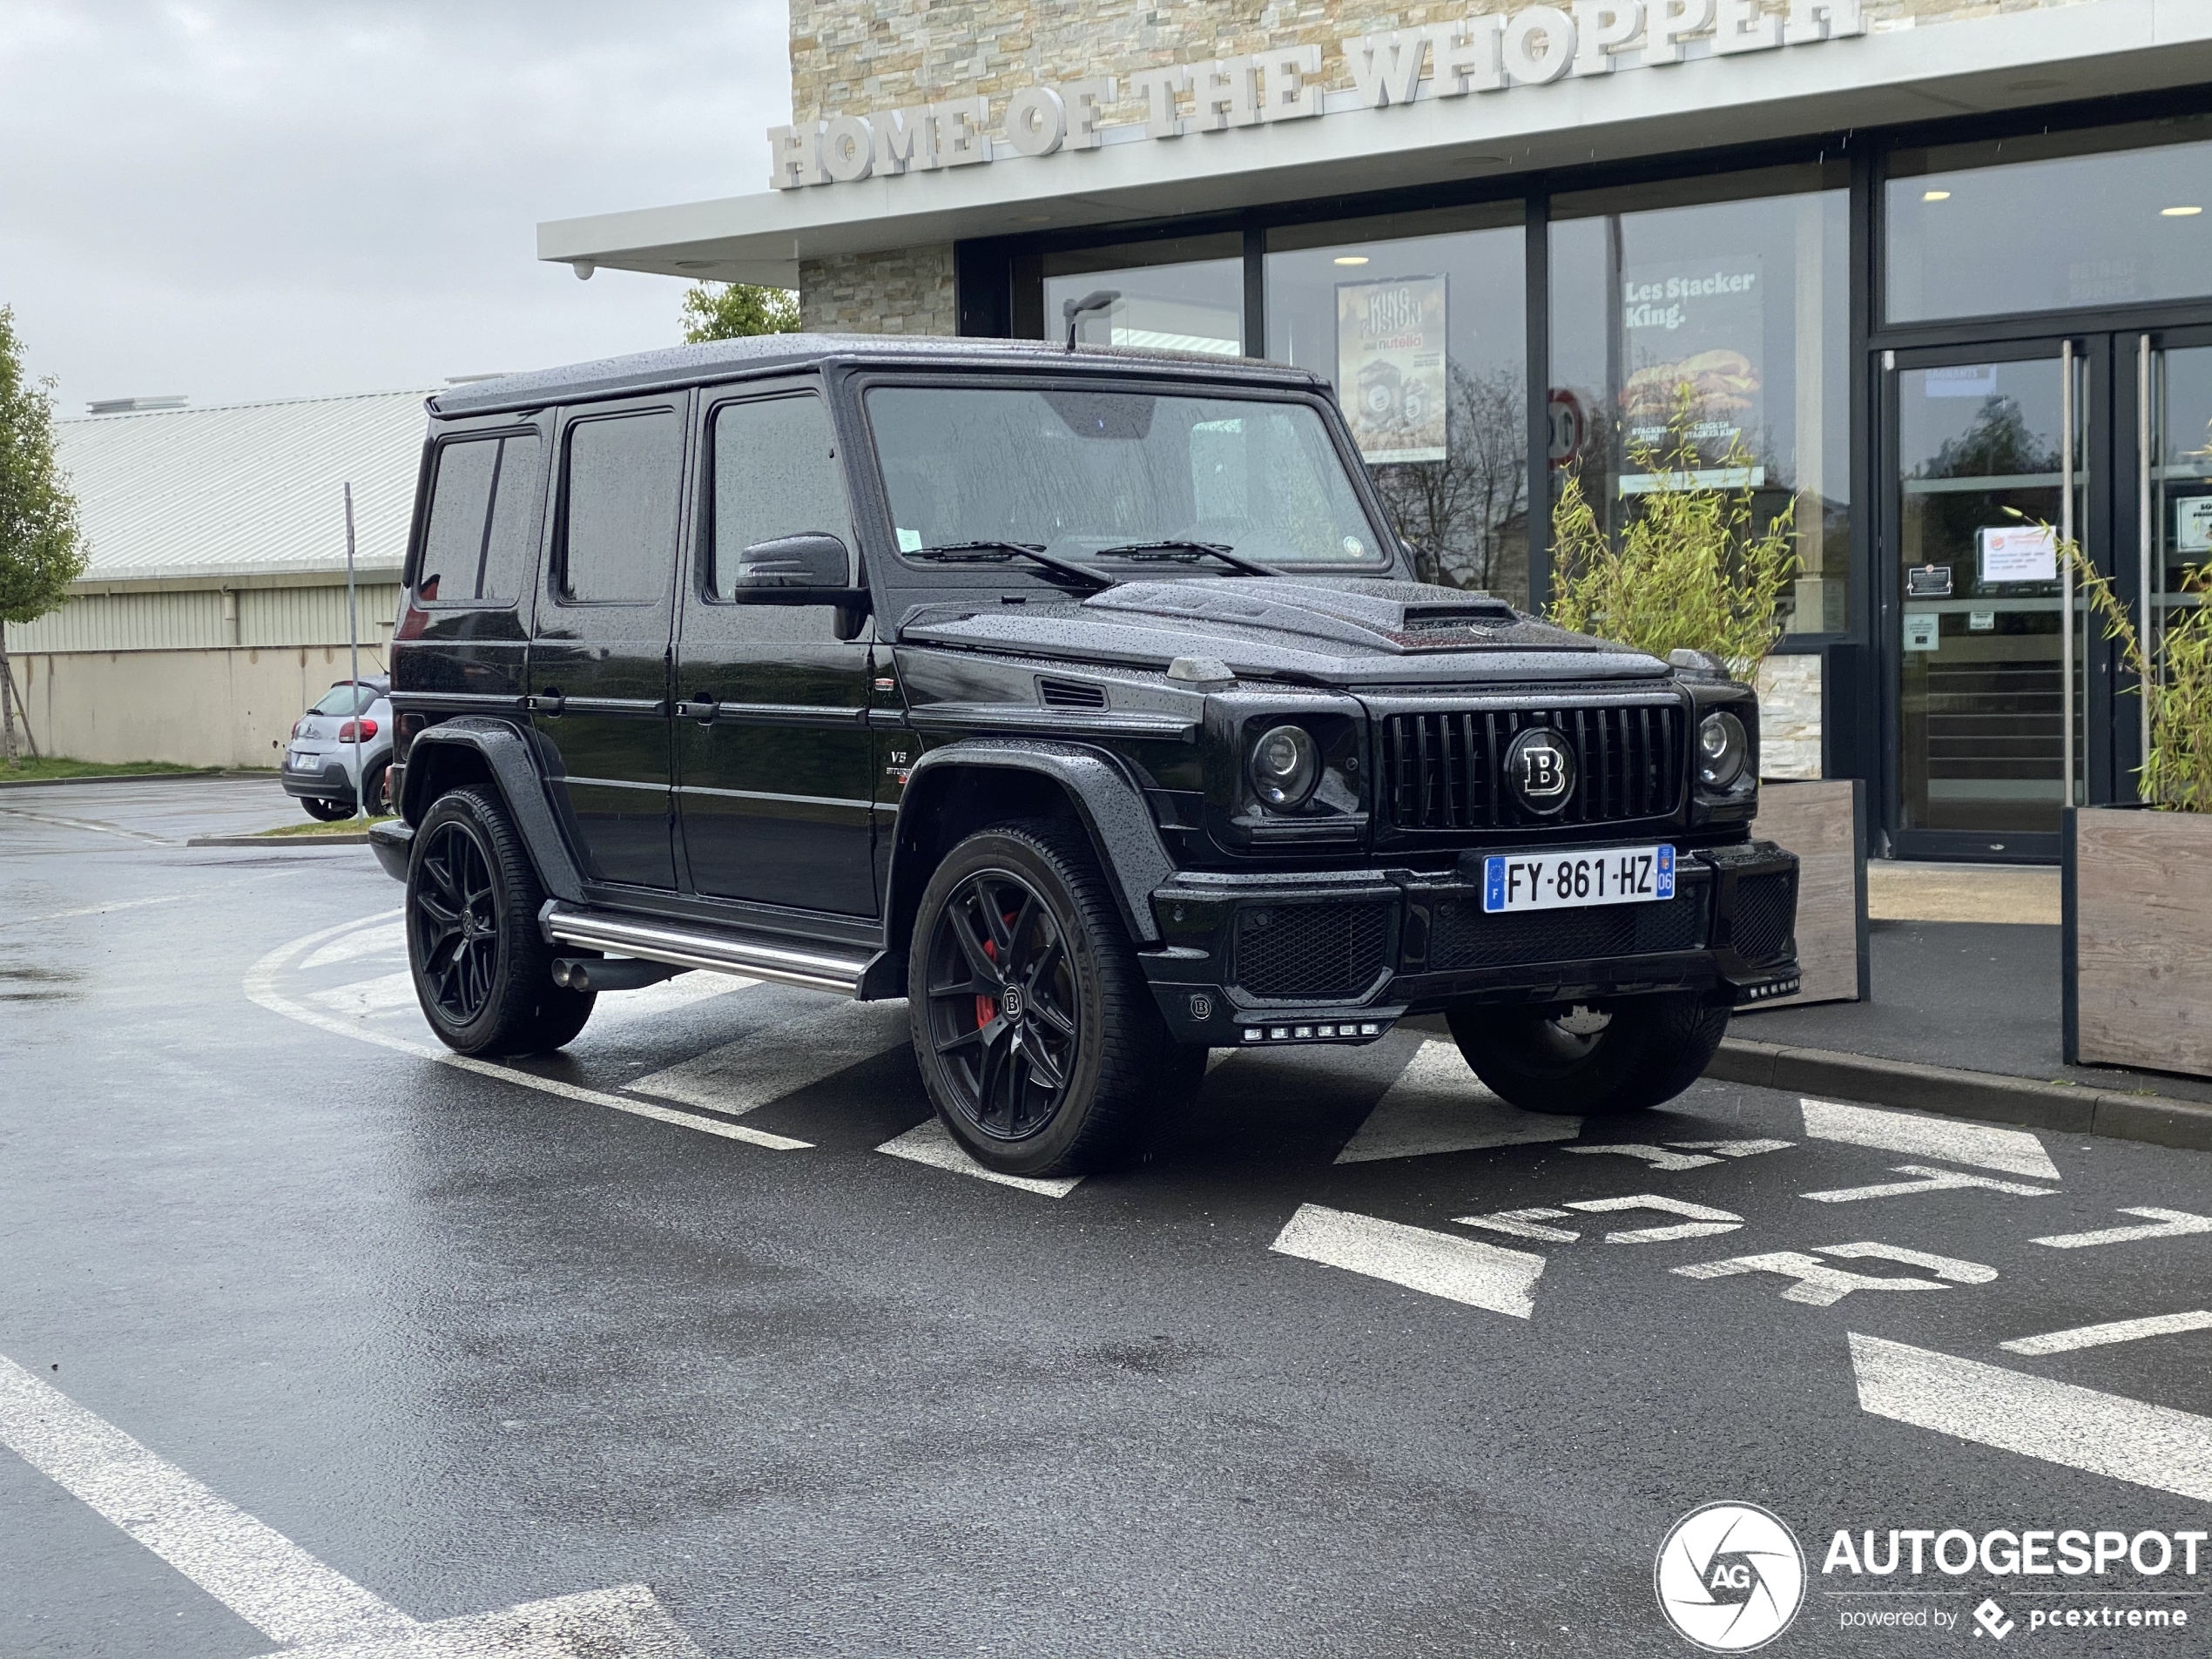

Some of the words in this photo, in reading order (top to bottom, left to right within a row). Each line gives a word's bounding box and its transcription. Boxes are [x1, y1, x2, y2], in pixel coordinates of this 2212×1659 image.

[767, 96, 992, 190] HOME
[1006, 77, 1117, 155] OF
[1132, 44, 1323, 138] THE
[1625, 282, 1663, 302] Les
[1666, 272, 1756, 298] Stacker
[1370, 287, 1410, 318] KING
[1360, 301, 1422, 338] FUSION
[1625, 304, 1686, 329] King.
[1379, 334, 1422, 350] nutella
[1631, 426, 1667, 435] STACKER
[1694, 421, 1730, 431] CHICKEN
[891, 751, 907, 763] V8
[1523, 746, 1566, 796] B
[1493, 888, 1499, 900] F
[1507, 855, 1653, 903] FY-861-HZ
[1658, 873, 1672, 890] 06
[1005, 992, 1020, 1015] B
[1194, 1000, 1209, 1015] B
